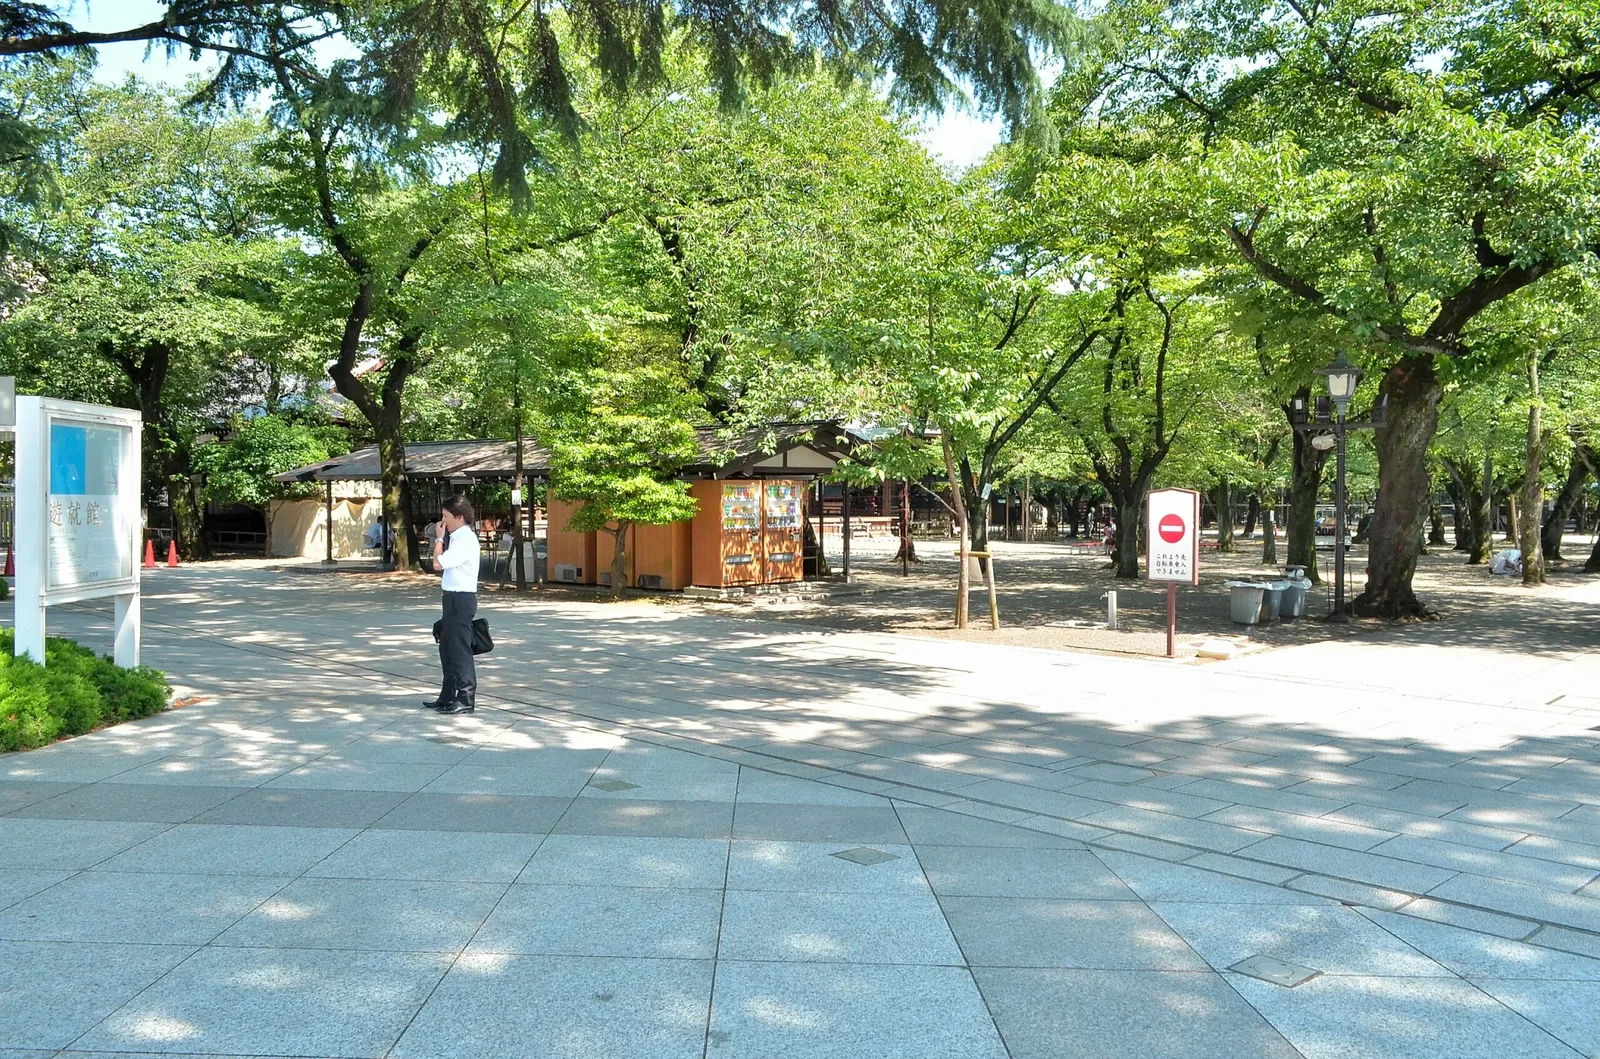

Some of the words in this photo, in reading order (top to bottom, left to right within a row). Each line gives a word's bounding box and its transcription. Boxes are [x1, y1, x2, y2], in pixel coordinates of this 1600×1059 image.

[50, 501, 99, 526] 遊就館
[1156, 553, 1187, 561] これより先
